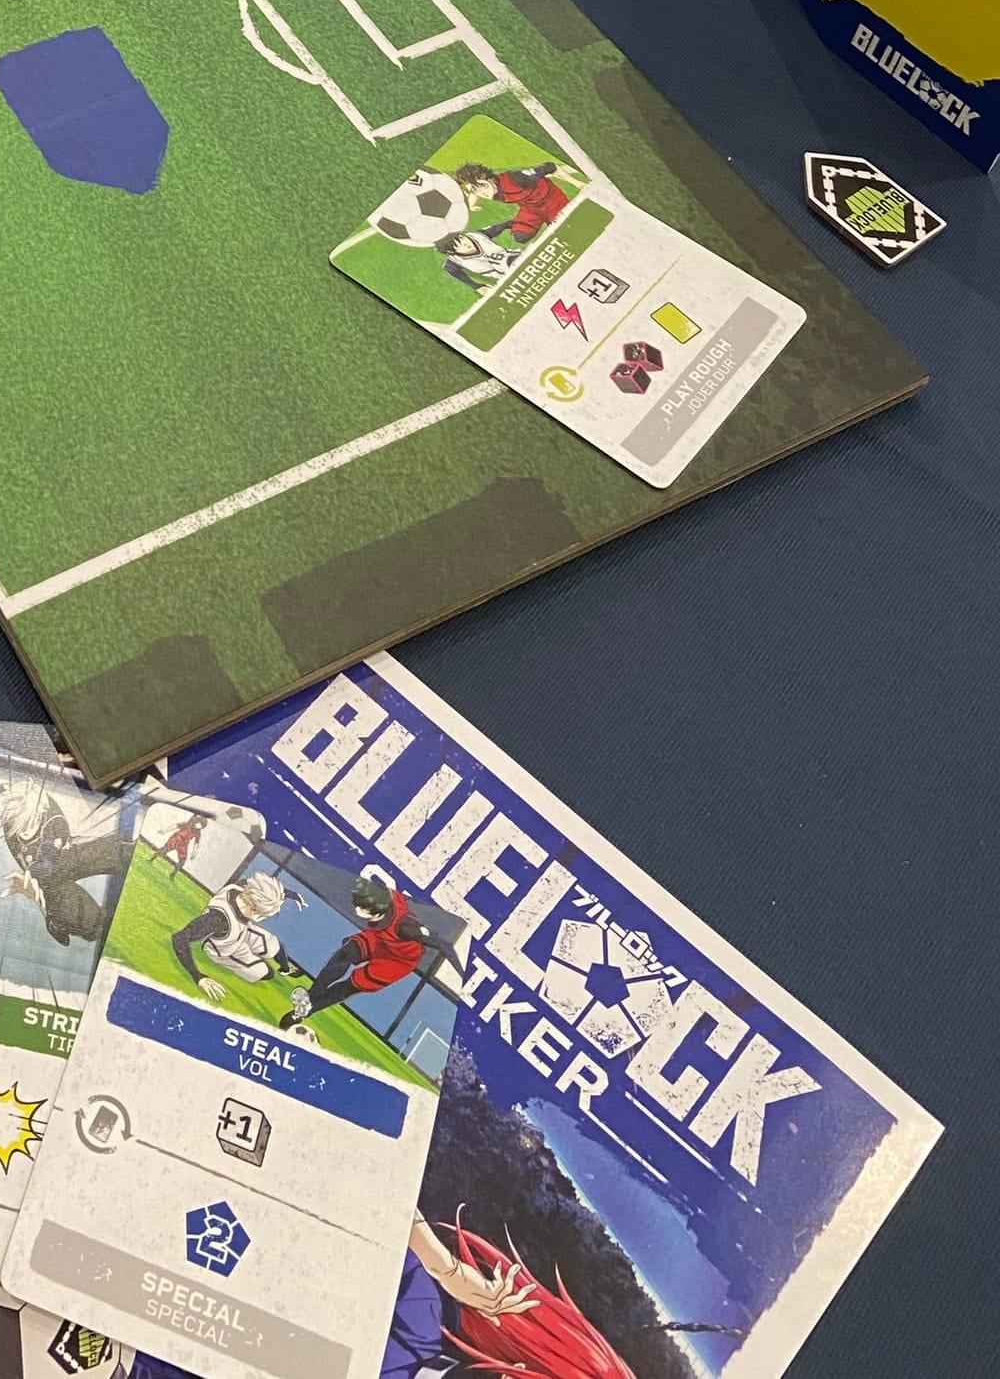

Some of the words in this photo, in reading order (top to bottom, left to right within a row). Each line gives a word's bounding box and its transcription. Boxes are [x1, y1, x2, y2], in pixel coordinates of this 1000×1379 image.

[851, 23, 981, 136] BLUELOCK
[852, 190, 906, 231] BLUELOCK
[499, 237, 565, 304] INTERCEPT
[587, 277, 612, 299] +1
[661, 380, 694, 416] PLAY
[688, 338, 732, 384] ROUGH
[687, 380, 718, 415] JOUER
[712, 357, 737, 381] DUR
[270, 672, 822, 1187] BLUELOCK
[571, 884, 688, 988] ブルーロック
[23, 1006, 80, 1035] STRI
[223, 1027, 296, 1072] STEAL
[238, 1054, 273, 1082] VOL
[218, 1111, 253, 1144] +1
[196, 1214, 234, 1265] 2
[140, 1270, 246, 1332] SPECIAL
[145, 1299, 230, 1349] SPÉCIAL
